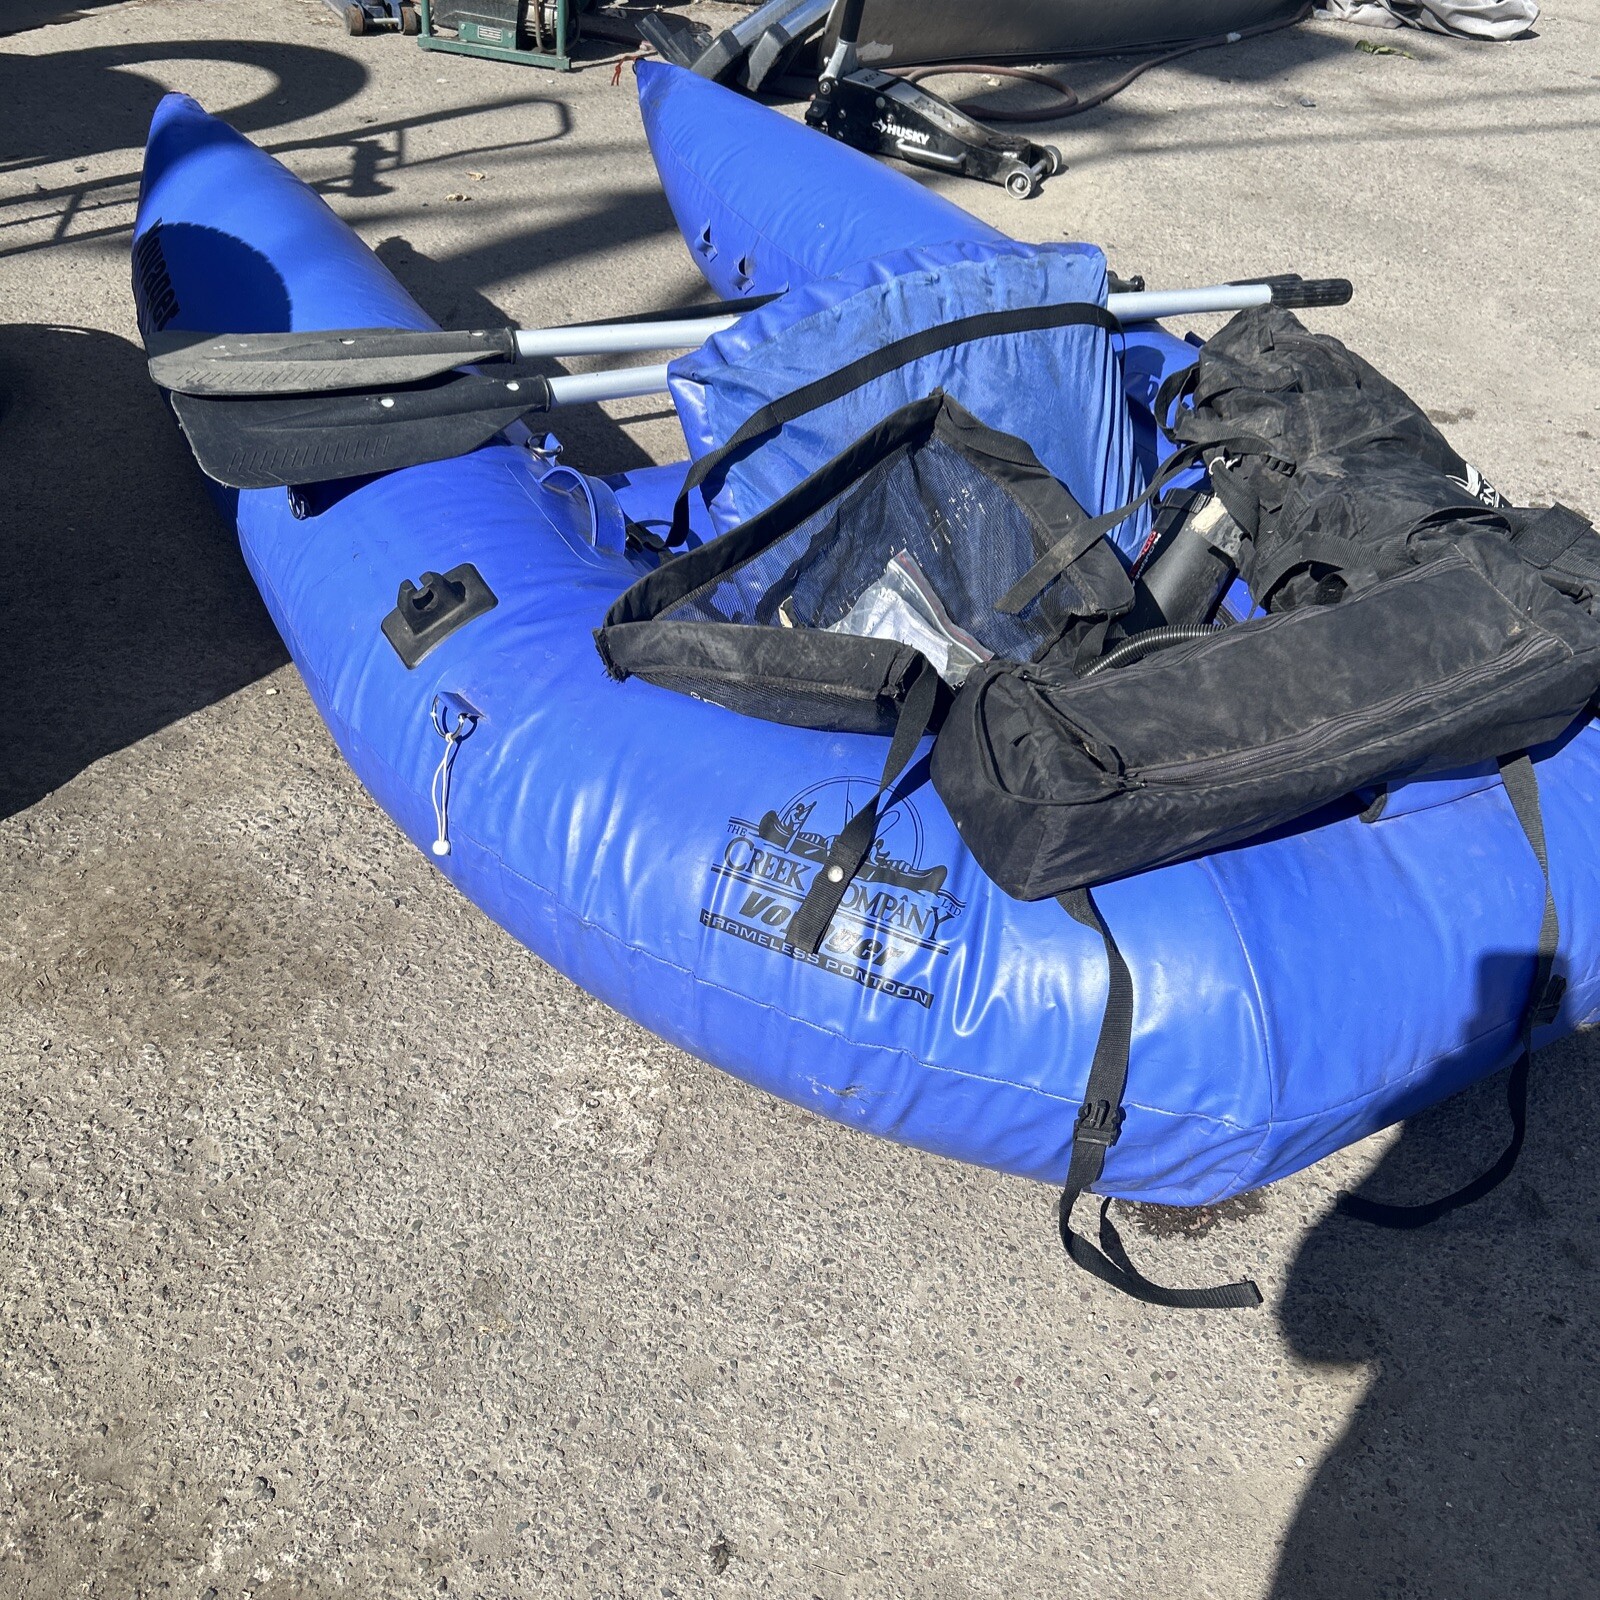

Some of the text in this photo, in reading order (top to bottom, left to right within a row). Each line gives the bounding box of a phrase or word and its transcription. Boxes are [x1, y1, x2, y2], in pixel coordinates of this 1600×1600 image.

[886, 123, 930, 145] HUSKY
[727, 823, 748, 837] THE
[724, 836, 955, 941] CREEK OMPÂNY
[702, 912, 928, 1005] FRAMELESS PONTOON
[739, 890, 906, 967] Voger
